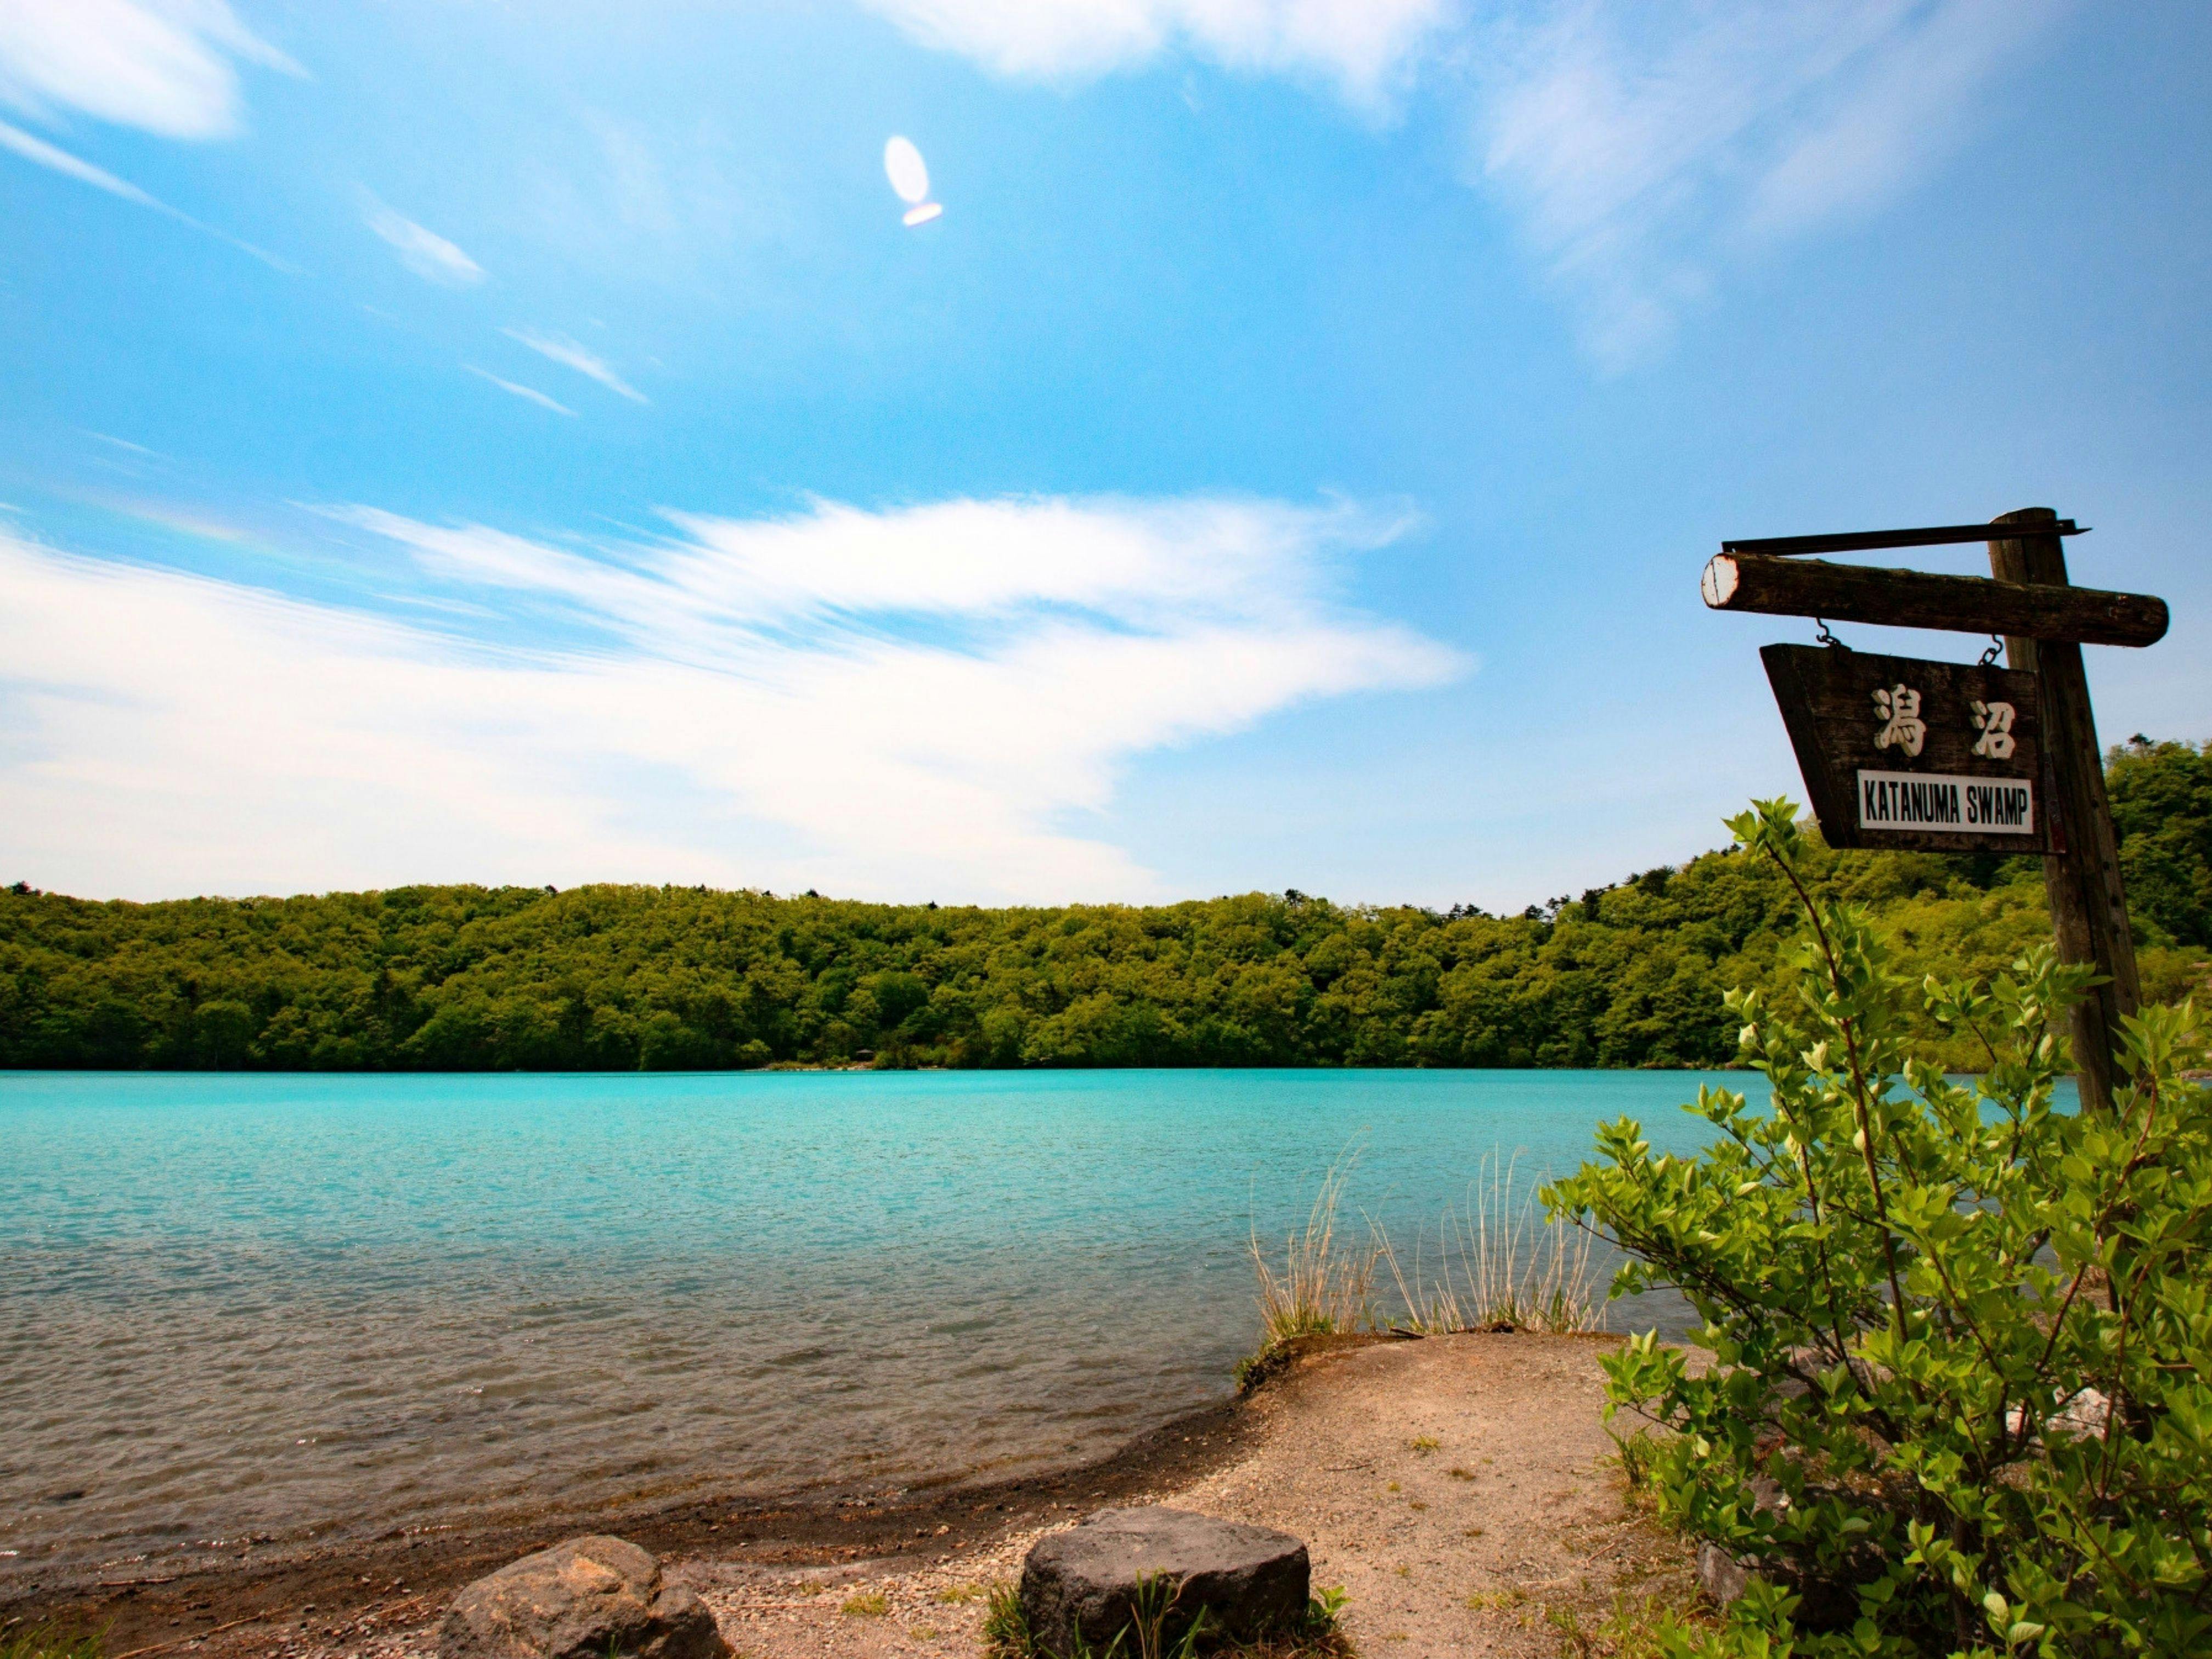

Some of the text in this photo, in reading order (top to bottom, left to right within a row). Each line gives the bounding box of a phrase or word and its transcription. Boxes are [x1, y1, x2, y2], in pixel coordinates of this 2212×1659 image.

[1871, 684, 2016, 759] 潟沼
[1864, 780, 2028, 826] KATANUMA SWAMP
